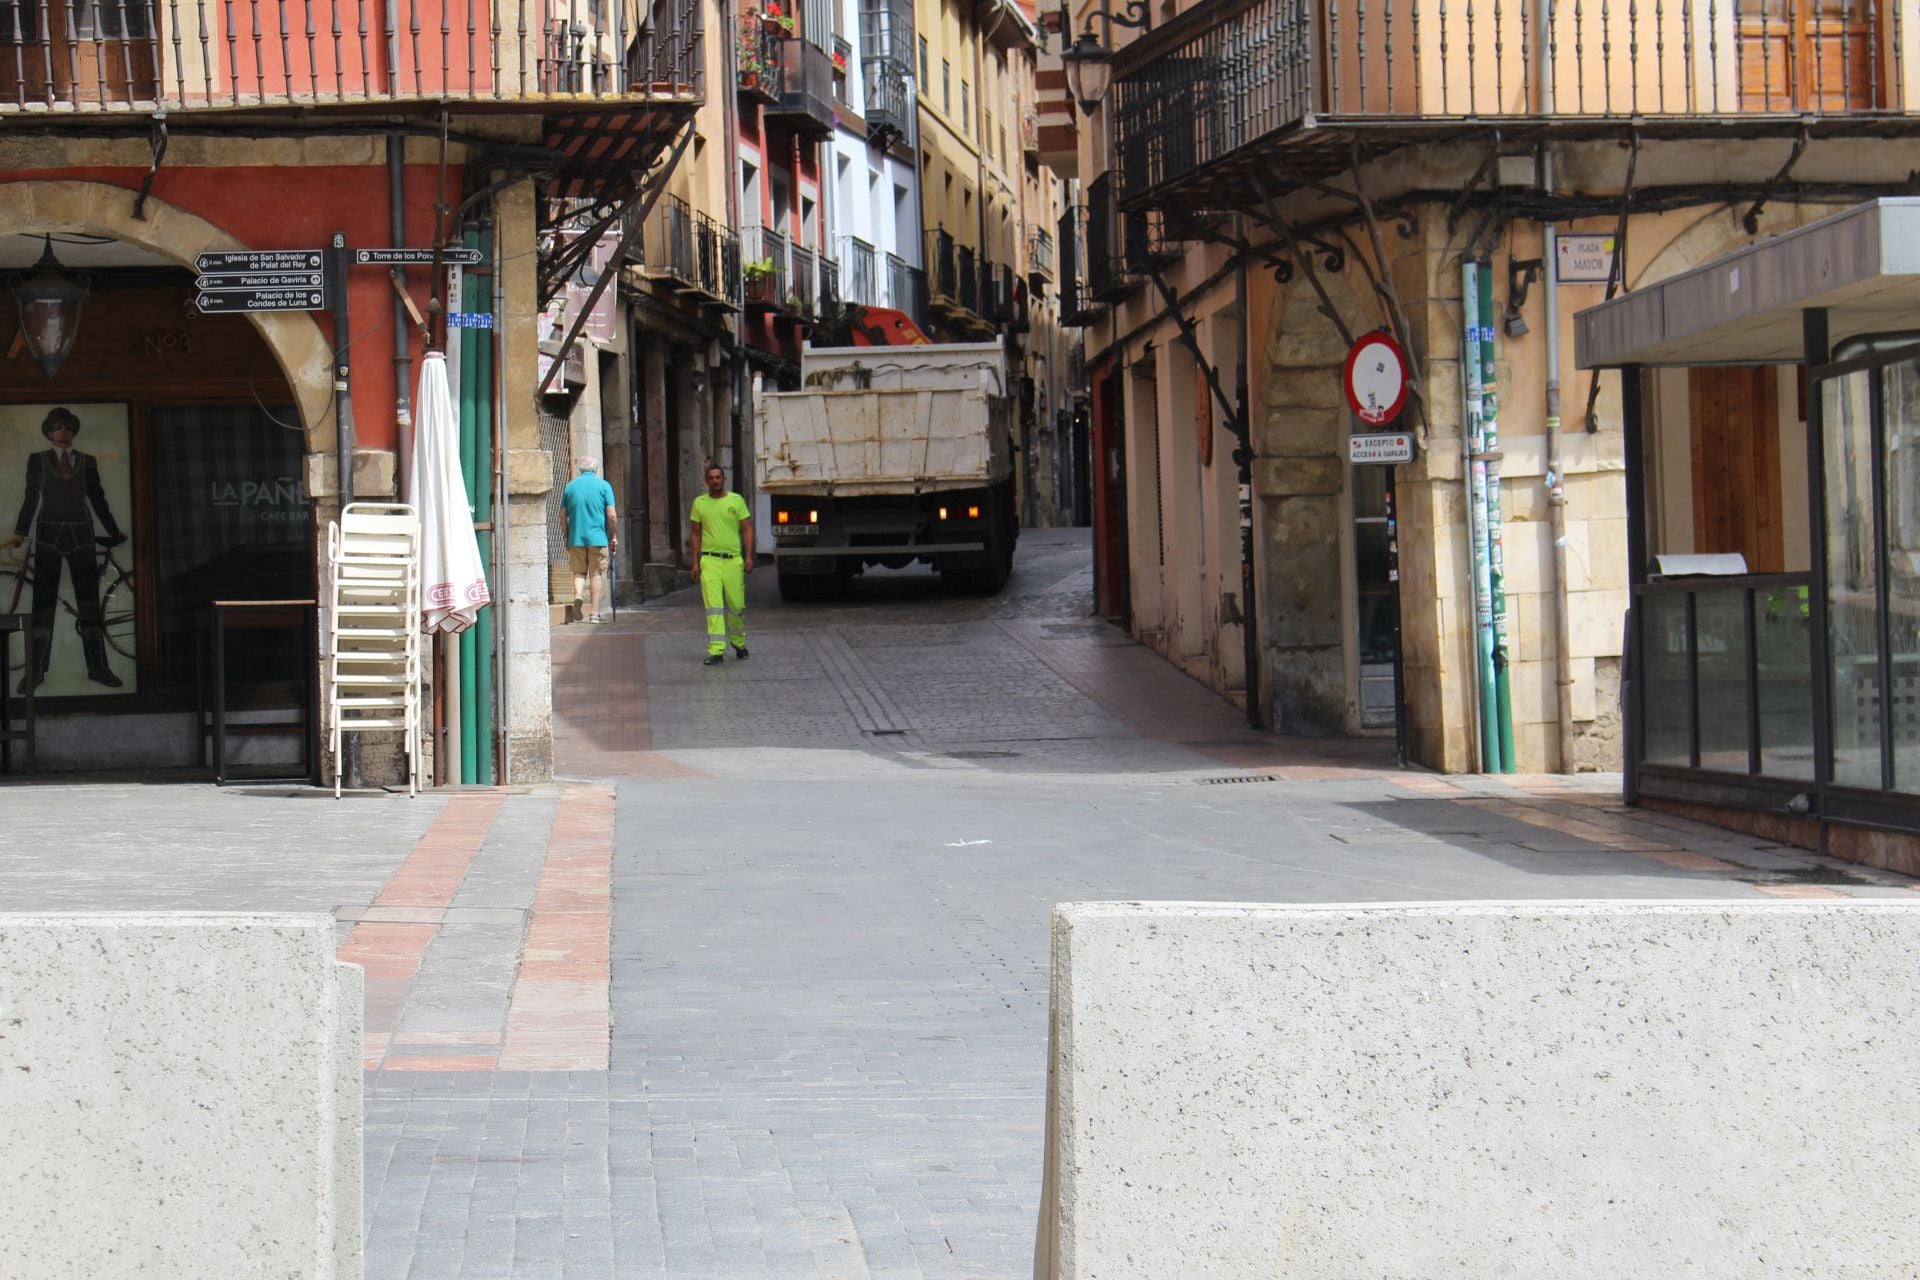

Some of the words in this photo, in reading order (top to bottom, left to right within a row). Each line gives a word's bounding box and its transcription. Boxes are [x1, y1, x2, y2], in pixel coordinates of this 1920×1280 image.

[1578, 243, 1600, 253] PLAZA
[225, 254, 248, 263] Iglesia
[275, 253, 306, 261] Salvador
[260, 261, 278, 269] Palat
[292, 261, 306, 269] Rey
[1574, 258, 1603, 270] MAYOR
[241, 276, 268, 284] Palacio
[270, 276, 279, 284] de
[1365, 439, 1394, 447] EXCEPTO
[212, 481, 237, 500] LA
